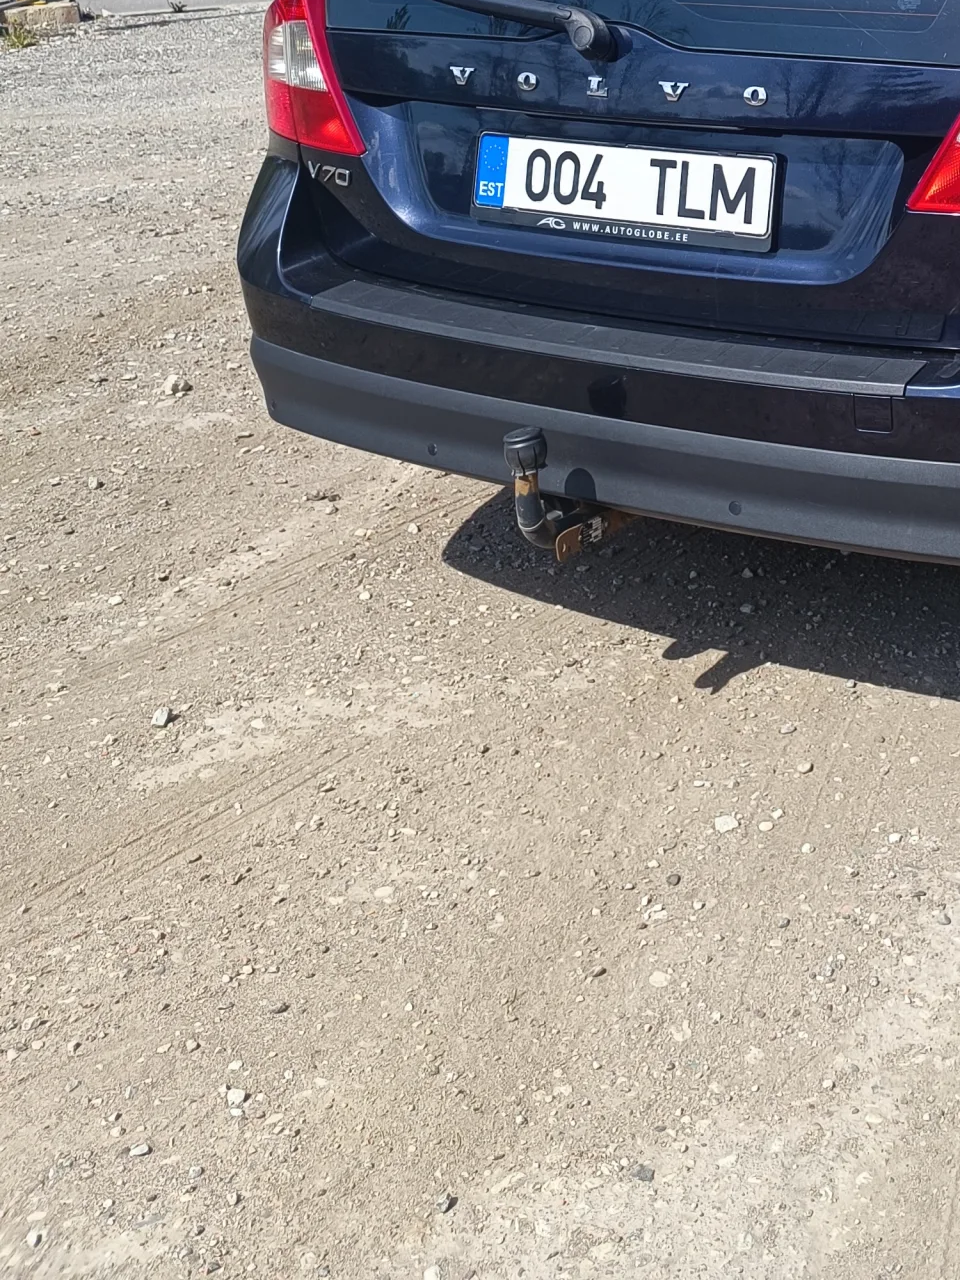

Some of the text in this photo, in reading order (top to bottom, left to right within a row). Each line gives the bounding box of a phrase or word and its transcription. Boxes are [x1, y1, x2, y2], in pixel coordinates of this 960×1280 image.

[450, 65, 768, 107] VOLVO
[308, 160, 350, 187] V70
[525, 148, 756, 225] 004 TLM
[479, 180, 504, 198] EST
[572, 221, 689, 242] WWW.AUTOGLOBE.EE
